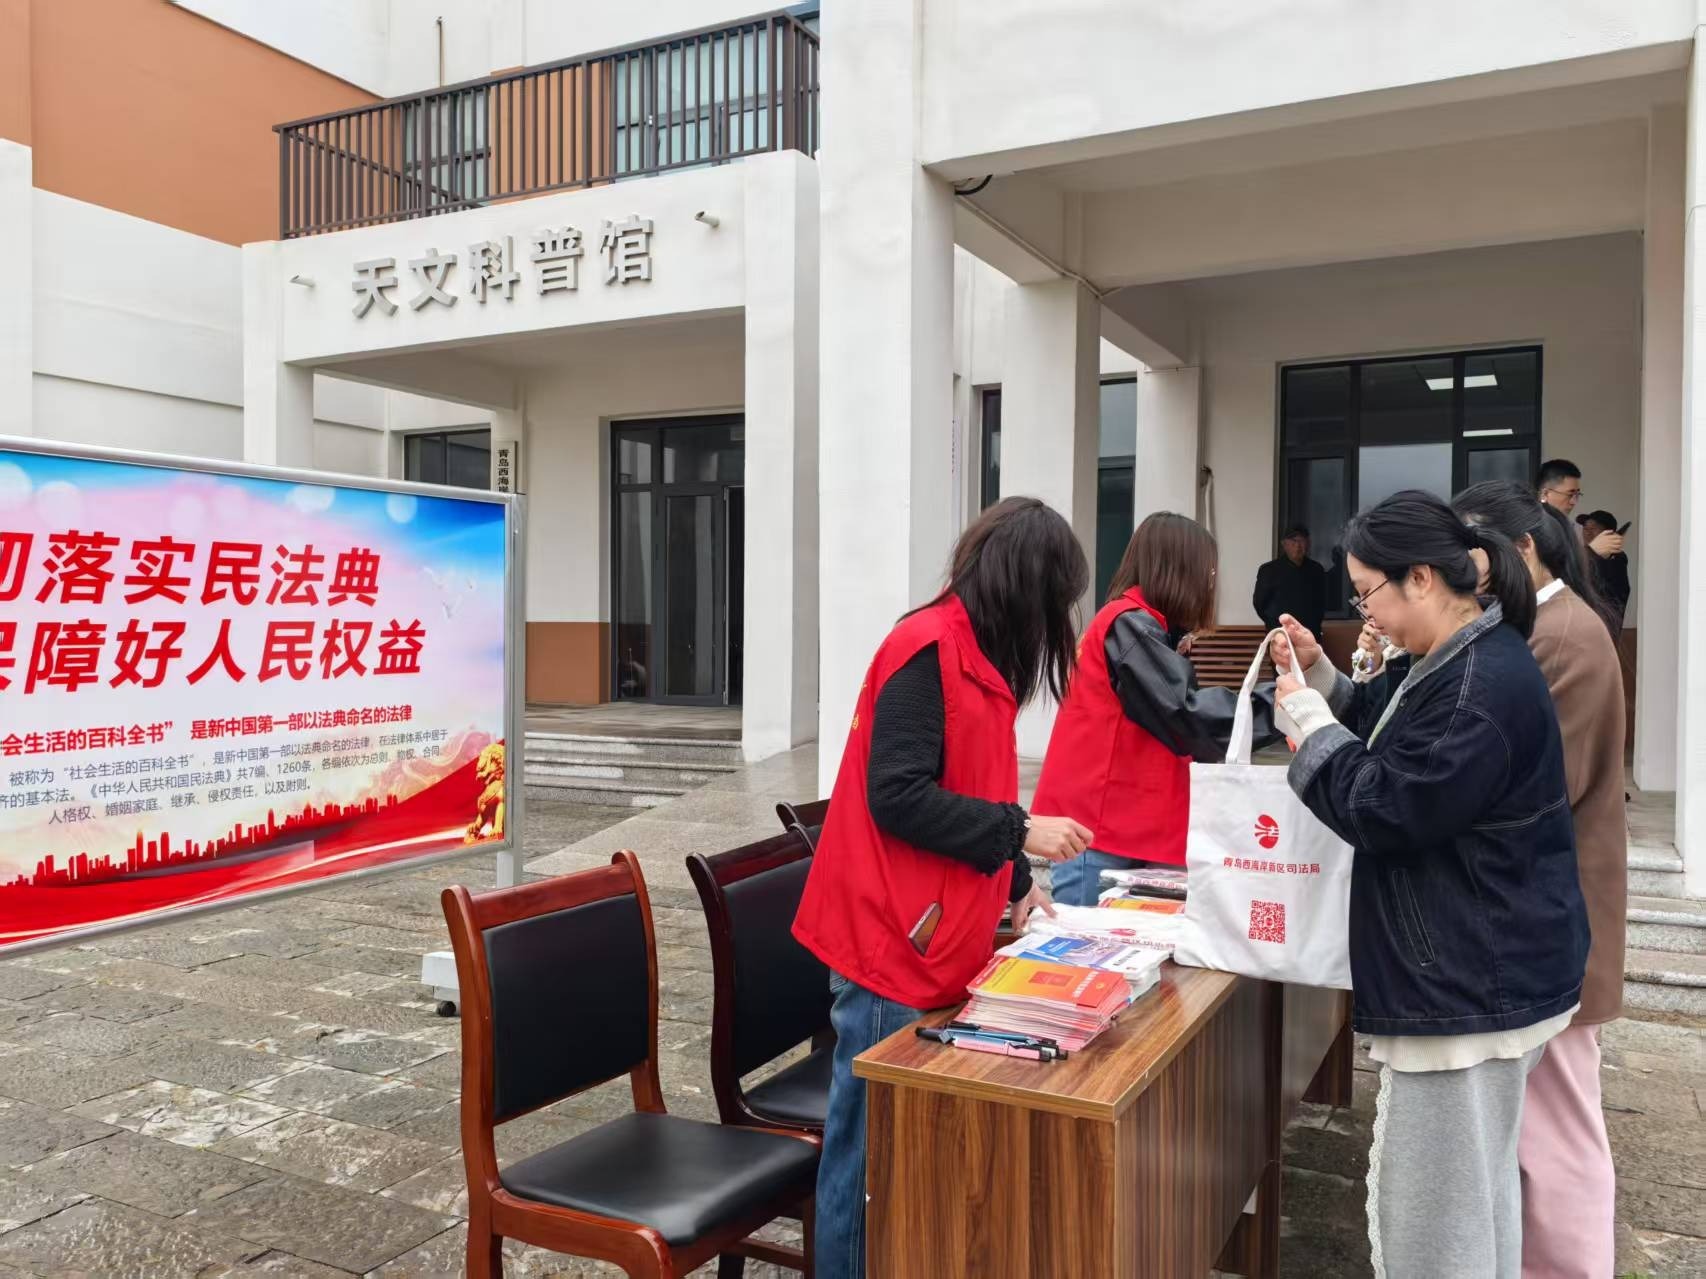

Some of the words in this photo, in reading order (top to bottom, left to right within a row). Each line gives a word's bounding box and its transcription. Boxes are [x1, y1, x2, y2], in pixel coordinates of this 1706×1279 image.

[352, 213, 654, 319] 天文科普馆
[0, 721, 173, 756] 会生活的百科全书”
[191, 704, 412, 740] 是新中国第一部以法典命名的法律
[1223, 857, 1320, 874] 青岛西海岸新区司法局
